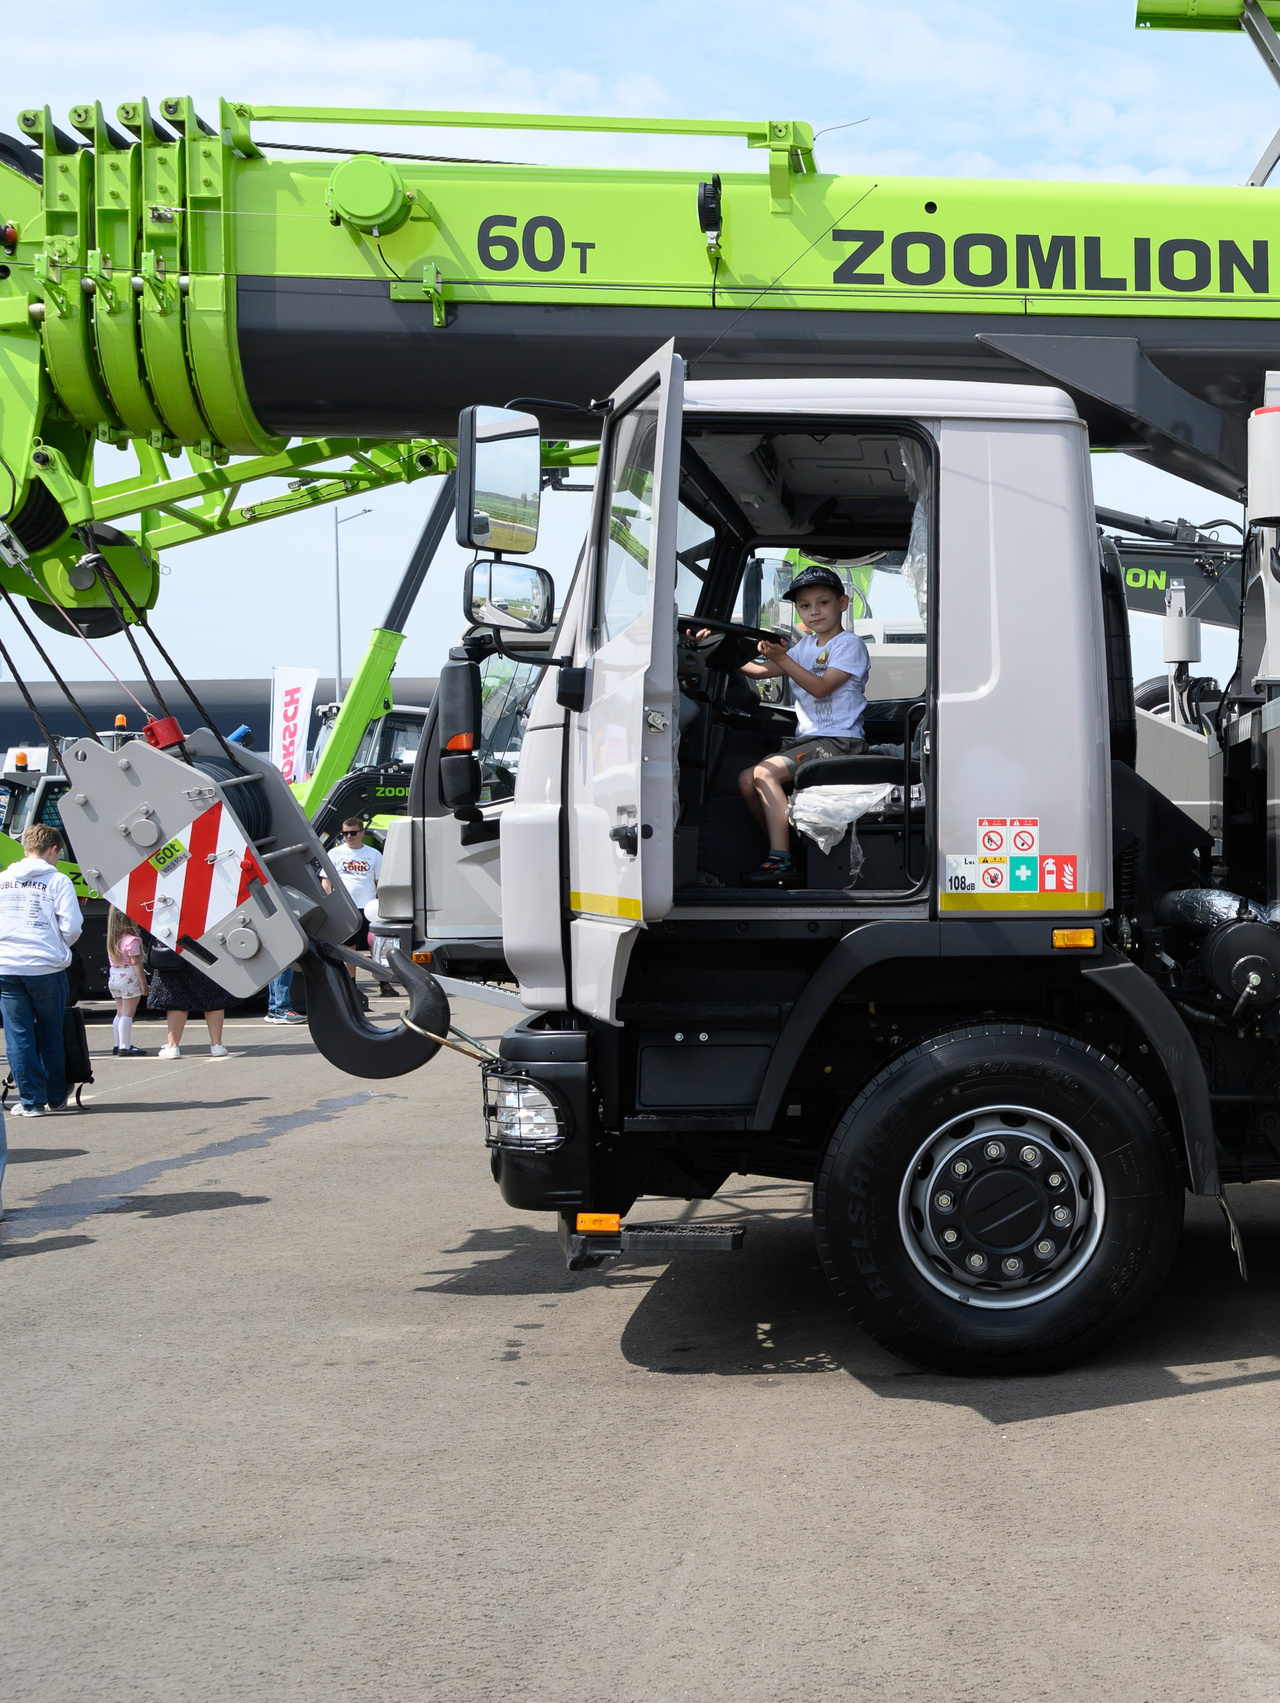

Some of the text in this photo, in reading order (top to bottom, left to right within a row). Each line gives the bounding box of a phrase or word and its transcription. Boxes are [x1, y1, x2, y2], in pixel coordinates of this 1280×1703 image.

[832, 228, 1270, 294] ZOOMLION
[155, 843, 180, 865] 60t
[21, 880, 48, 892] MAKER
[848, 1097, 910, 1302] BELSHINA
